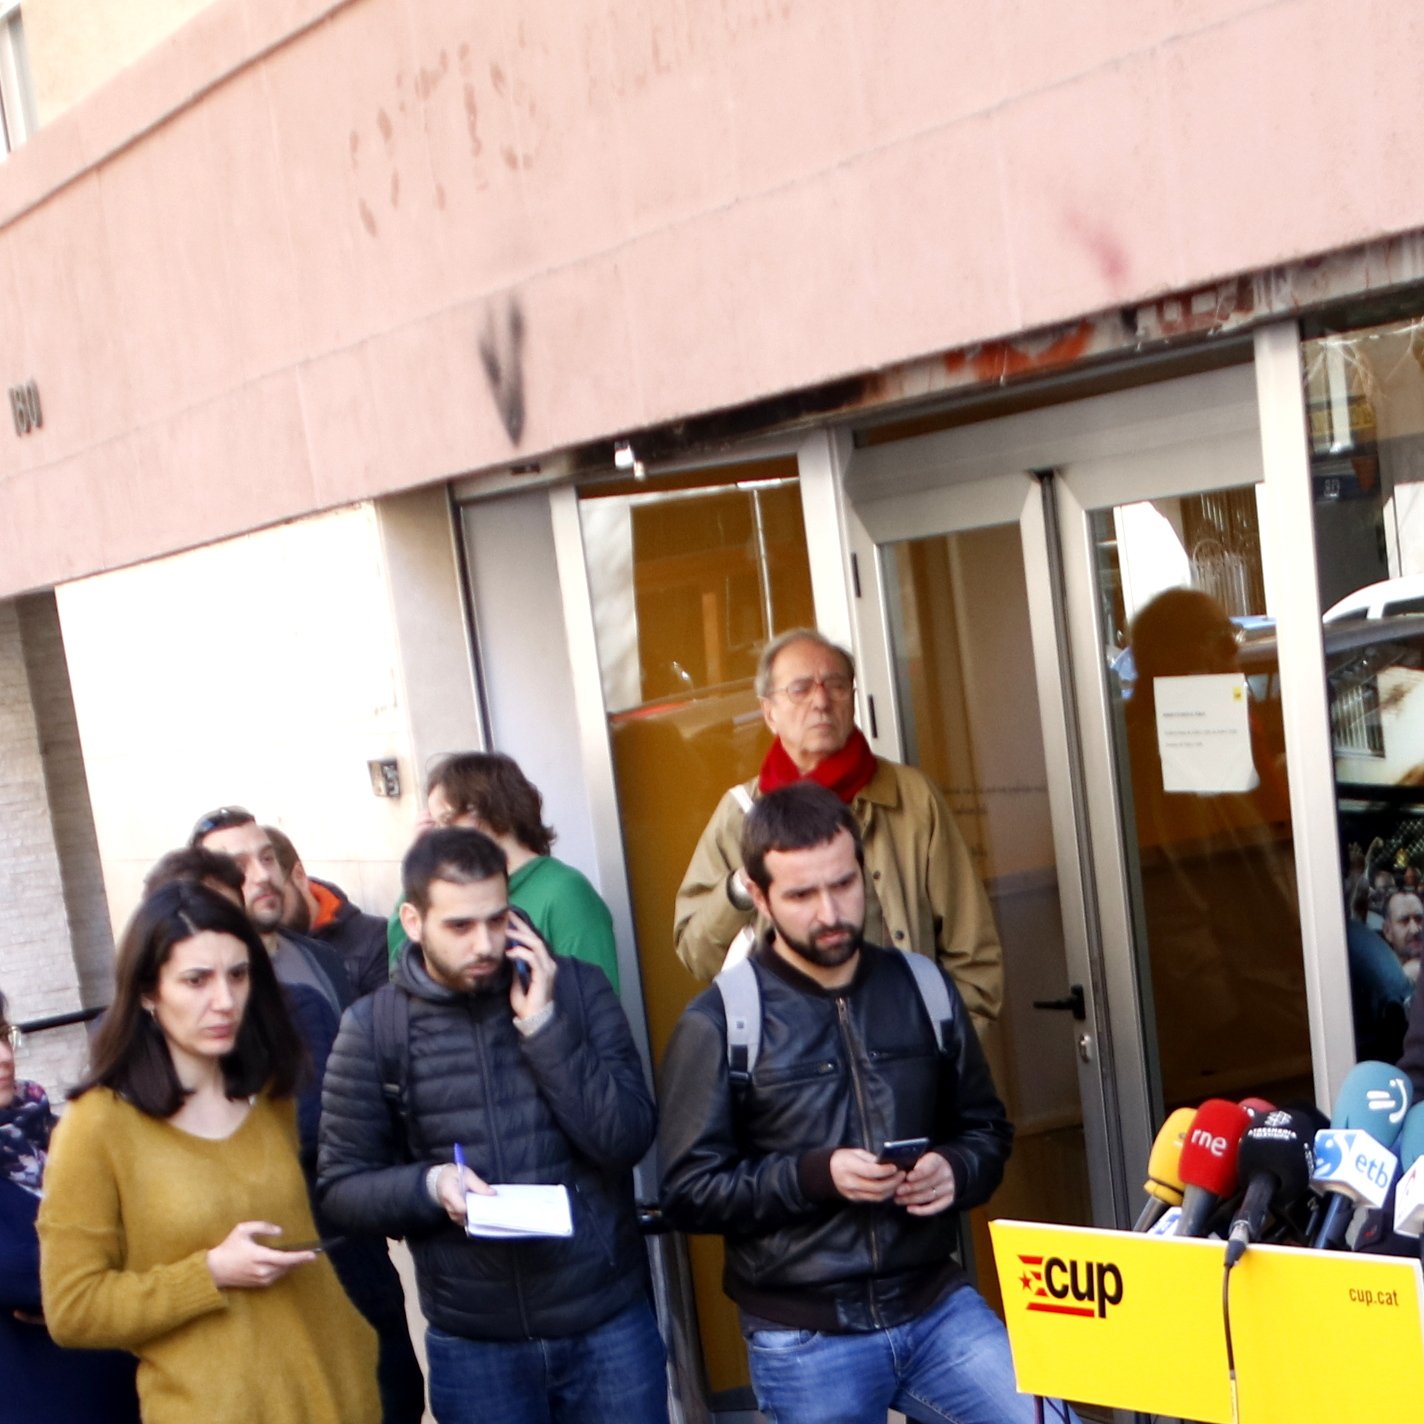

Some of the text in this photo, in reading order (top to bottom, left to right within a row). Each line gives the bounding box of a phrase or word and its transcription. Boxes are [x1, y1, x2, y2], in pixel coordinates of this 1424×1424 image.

[1191, 1129, 1228, 1157] rne
[1355, 1153, 1389, 1189] etb
[1044, 1256, 1124, 1319] cup
[1349, 1286, 1400, 1308] cup.cat
